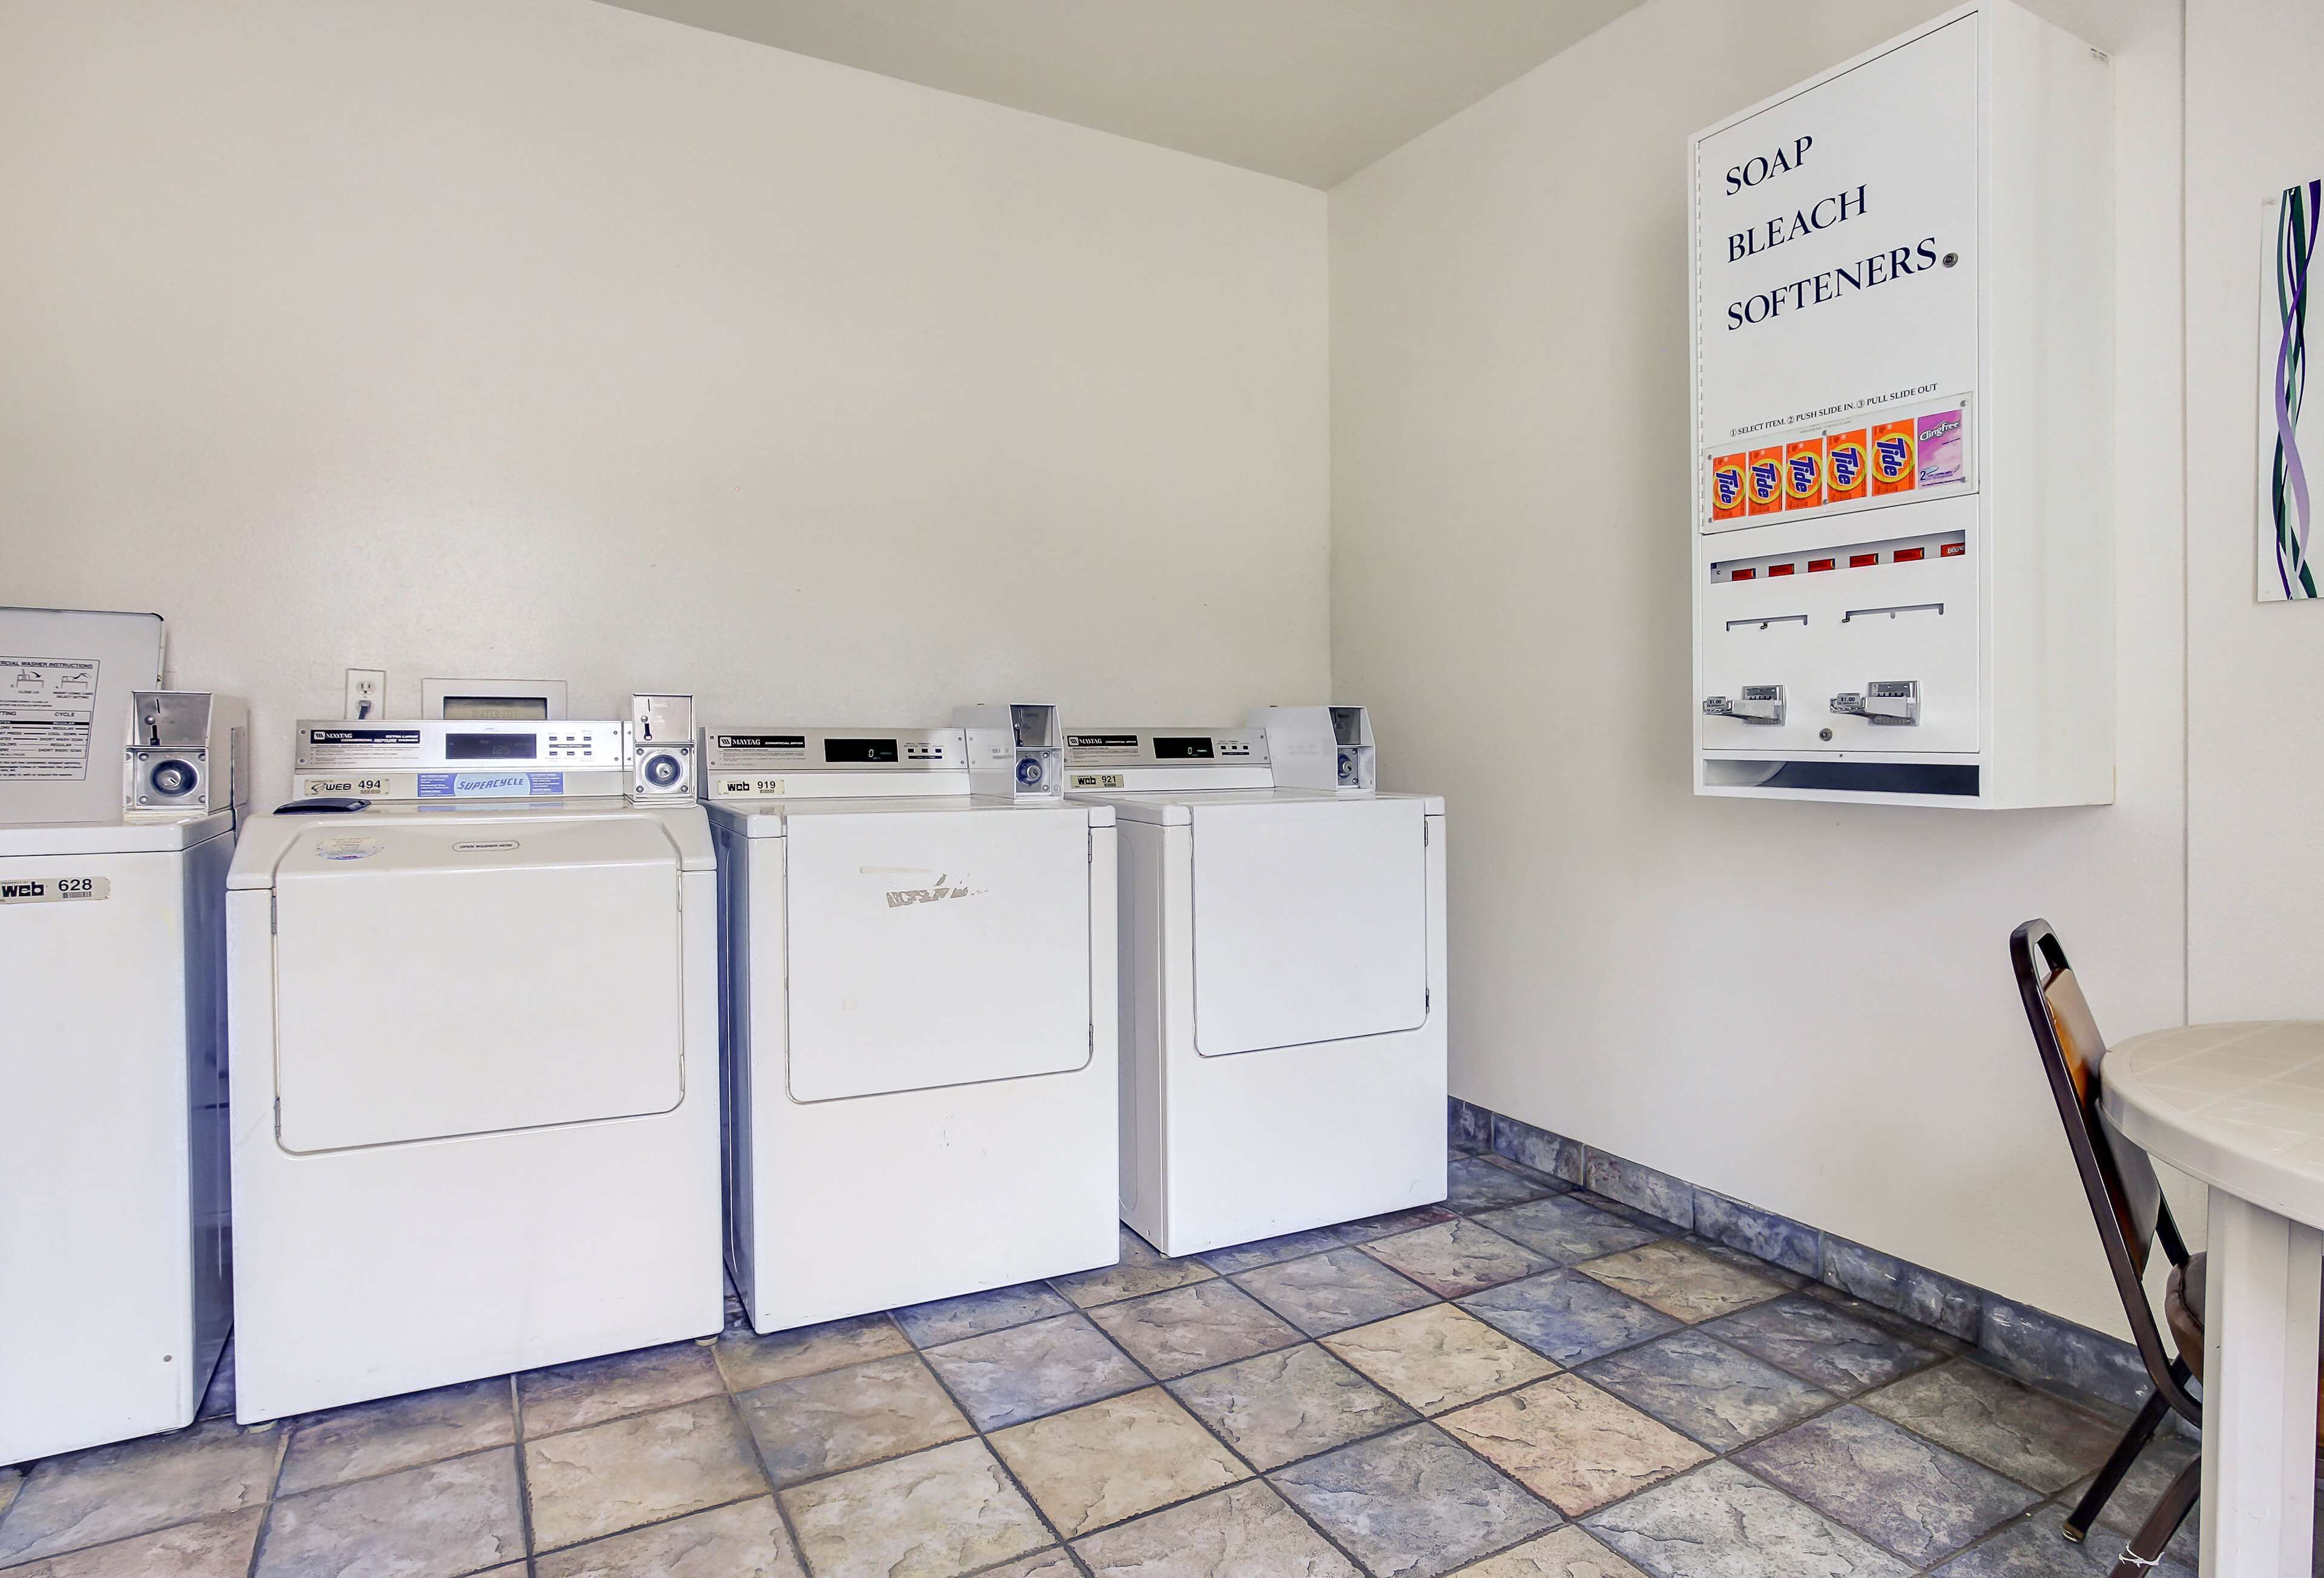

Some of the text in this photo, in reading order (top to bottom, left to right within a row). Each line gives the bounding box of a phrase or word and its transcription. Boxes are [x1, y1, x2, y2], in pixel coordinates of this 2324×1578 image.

[1726, 136, 1812, 196] SOAP
[1727, 184, 1867, 263] BLEACH
[1728, 237, 1937, 330] SOFTENERS
[1738, 423, 1763, 434] SELECT
[1796, 411, 1817, 421] PUSH
[1819, 404, 1842, 416] SLIDE
[1866, 394, 1888, 406] PULL
[1890, 388, 1915, 400] SLIDE
[1918, 383, 1938, 394] OUT
[1789, 456, 1815, 493] Tide
[1831, 447, 1859, 485] Tide
[1876, 437, 1906, 477] Tide
[1716, 469, 1739, 504] Tide
[1752, 463, 1776, 498] Tide
[1920, 470, 1926, 481] 2
[869, 749, 874, 758] 0
[358, 780, 381, 788] 494
[457, 779, 524, 790] SUPERCYCLE
[58, 879, 92, 891] 628
